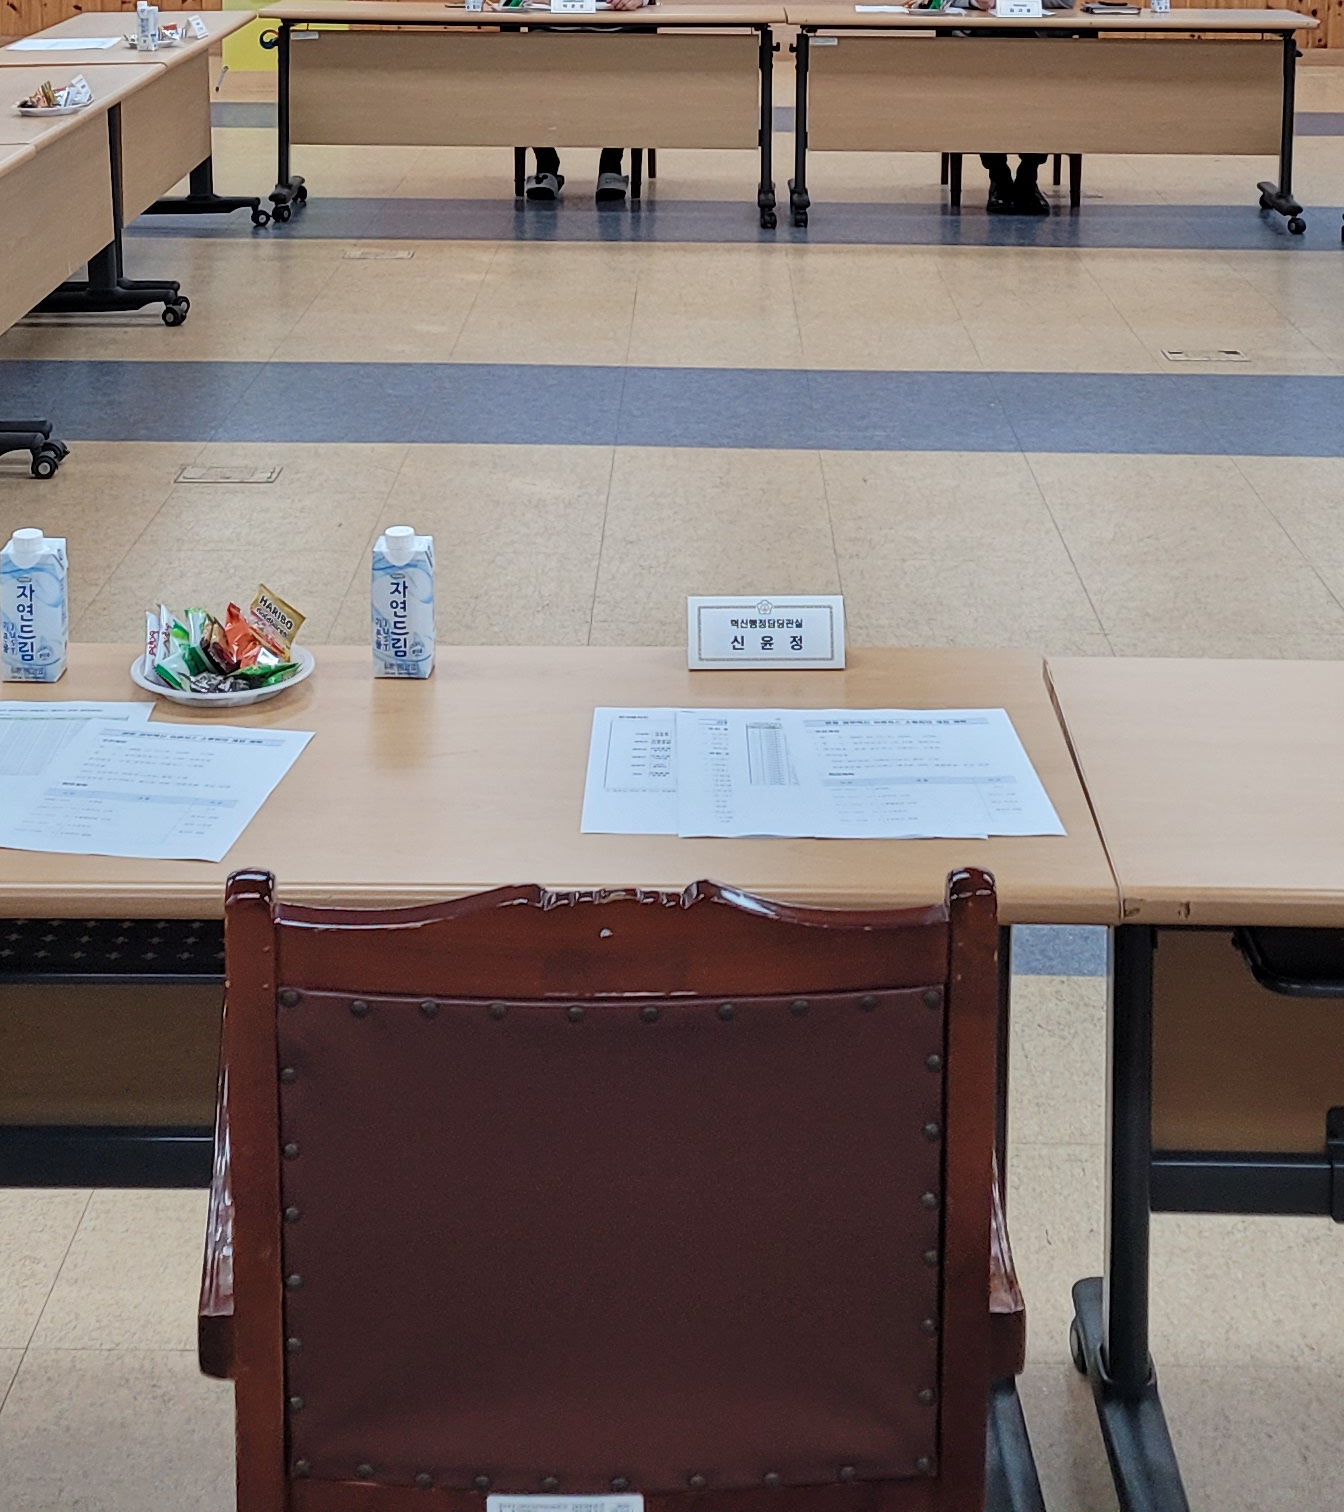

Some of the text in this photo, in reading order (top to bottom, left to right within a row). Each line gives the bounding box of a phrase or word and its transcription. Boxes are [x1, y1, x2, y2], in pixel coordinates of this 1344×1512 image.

[16, 583, 36, 662] 자연드림
[259, 595, 294, 631] HARIBO
[389, 580, 410, 658] 자연드림
[730, 618, 803, 629] 혁신행정담당관실
